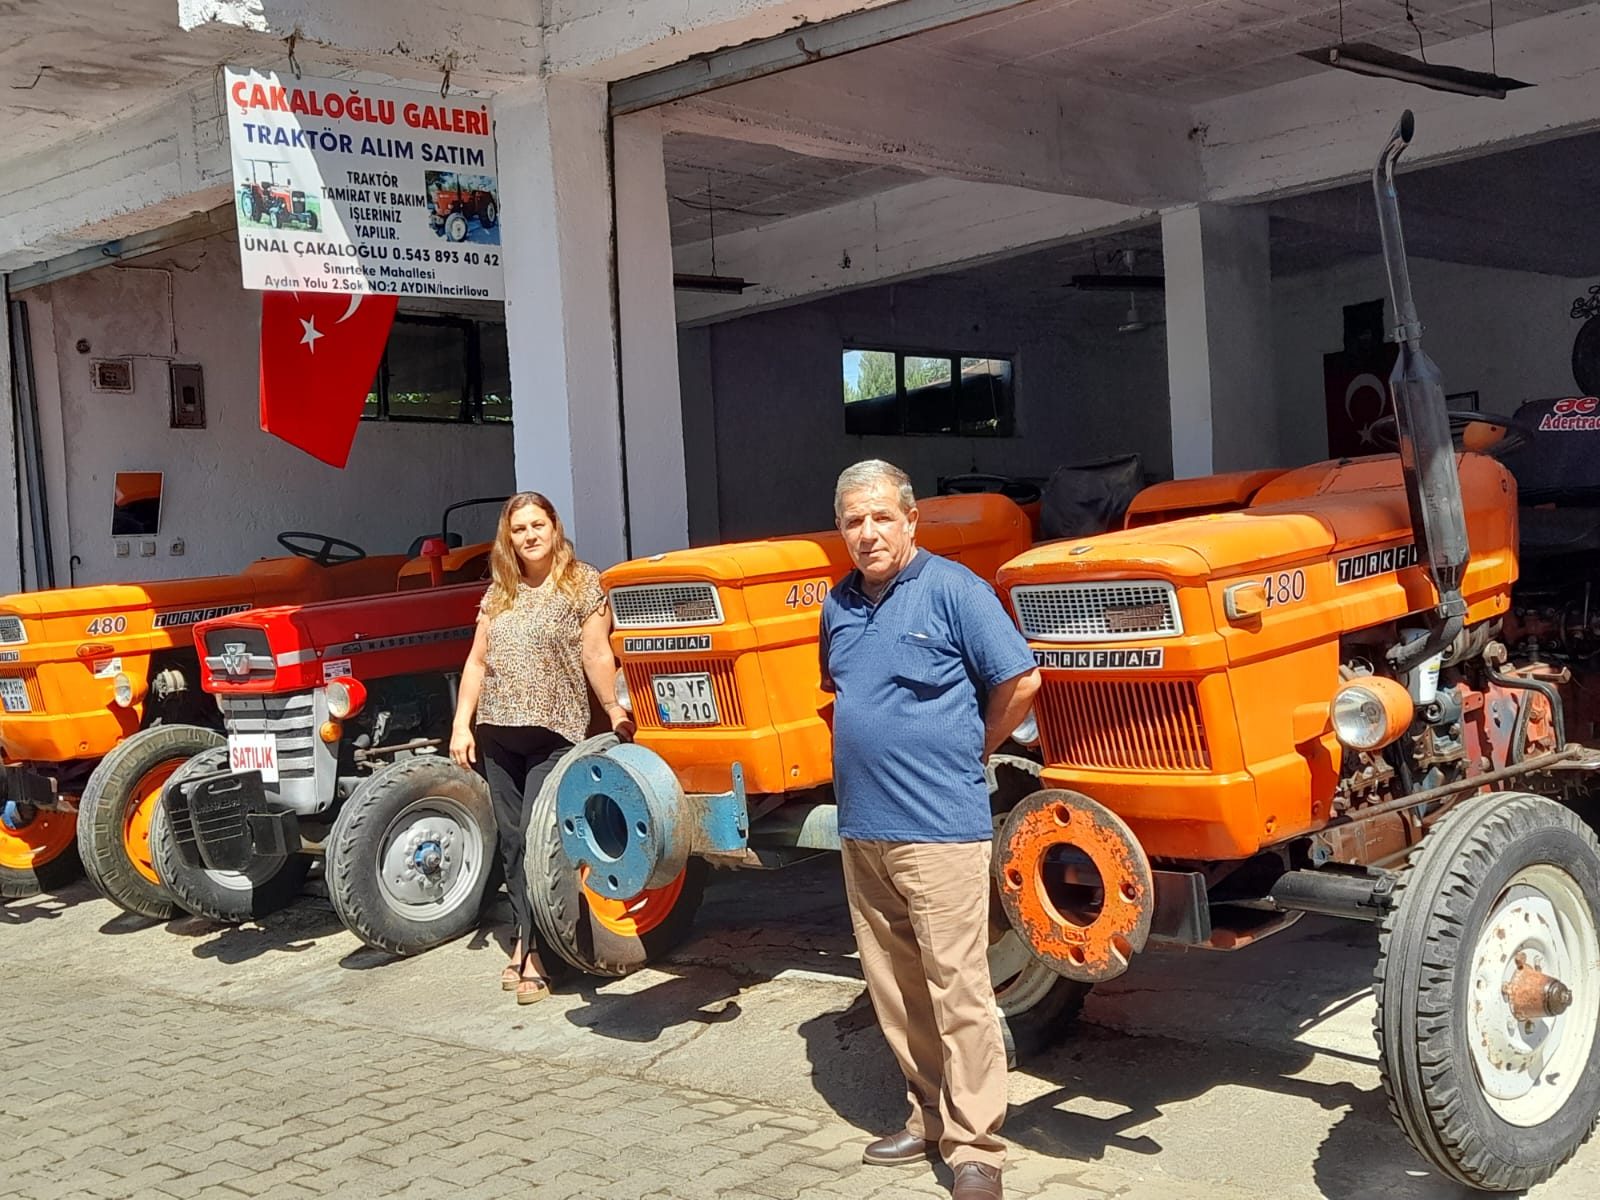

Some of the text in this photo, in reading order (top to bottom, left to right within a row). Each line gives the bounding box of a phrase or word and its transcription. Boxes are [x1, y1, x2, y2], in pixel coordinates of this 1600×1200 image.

[231, 81, 489, 136] ÇAKALOĞLU GALERİ
[243, 123, 485, 167] TRAKTÖR ALIM SATIM
[346, 170, 398, 188] TRAKTÖR
[321, 185, 426, 208] TAMİRAT VE BAKIM
[349, 203, 402, 223] İŞLERİNİZ
[355, 225, 400, 240] YAPILIR.
[244, 234, 499, 266] ÜNAL ÇAKALOĞLU 0.543 893 40 42
[380, 265, 436, 279] Mahallesi
[264, 275, 300, 289] Aydın
[303, 276, 328, 289] Yolu
[368, 280, 397, 293] NO:2
[1540, 413, 1600, 431] Adertrac
[1339, 546, 1418, 582] TURKFI
[786, 581, 827, 608] 480
[1263, 570, 1305, 608] 480
[87, 616, 127, 635] 480
[625, 635, 710, 652] TURKFIAT
[1033, 650, 1160, 668] TURKFIAT
[657, 680, 706, 698] 09 YF
[681, 702, 711, 721] 210
[232, 746, 274, 769] SATILIK
